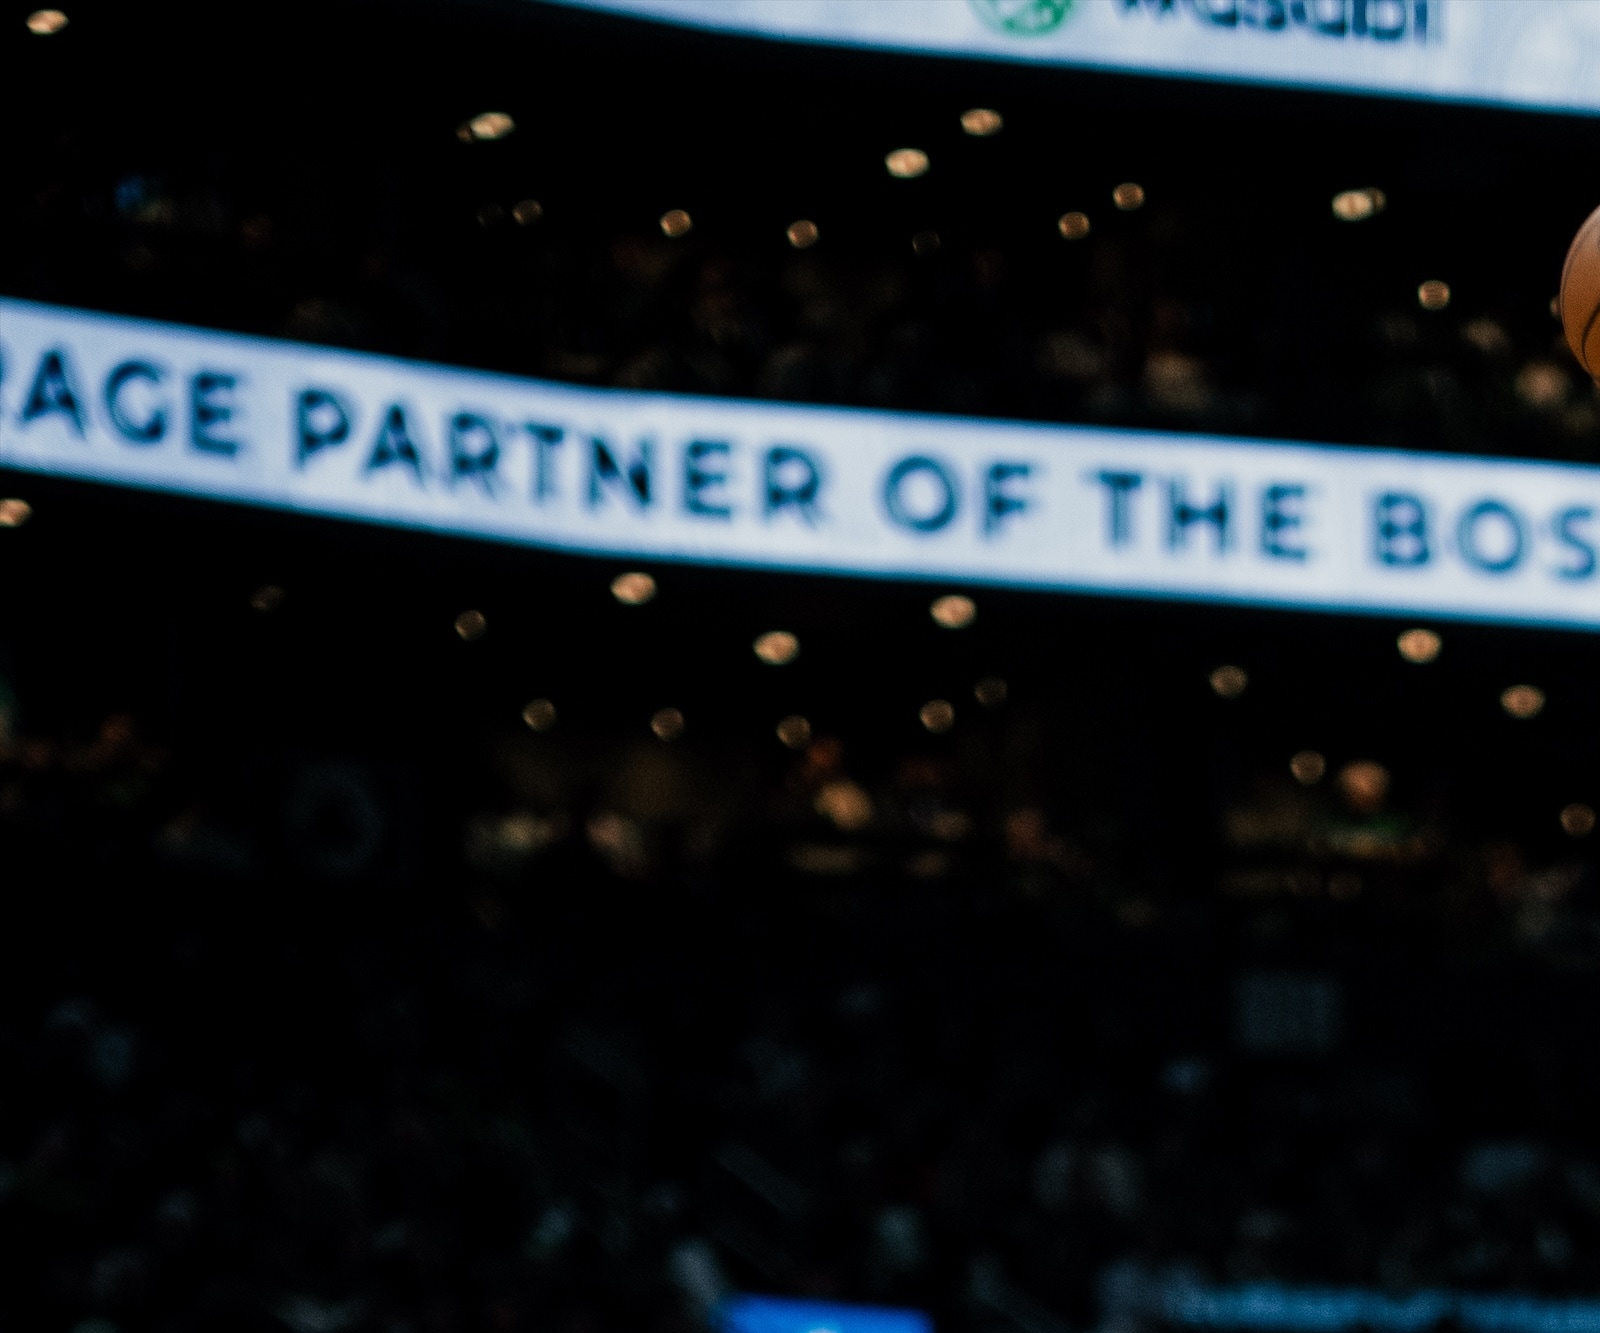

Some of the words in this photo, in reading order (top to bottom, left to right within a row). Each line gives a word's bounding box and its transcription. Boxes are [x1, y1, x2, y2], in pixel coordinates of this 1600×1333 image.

[0, 345, 243, 460] AGE
[290, 385, 828, 530] PARTNER
[878, 452, 1036, 541] OF
[1092, 465, 1315, 565] THE
